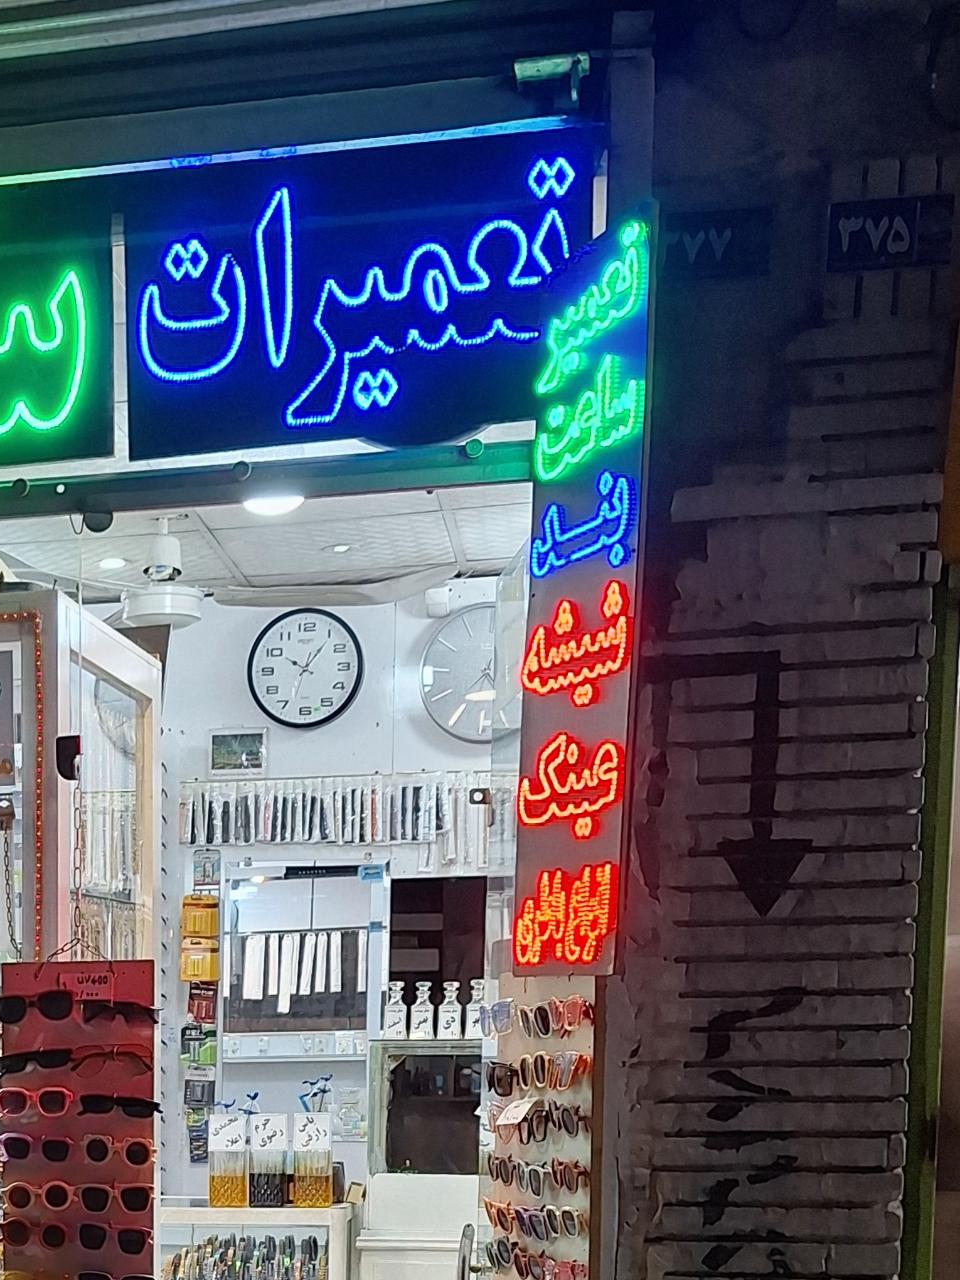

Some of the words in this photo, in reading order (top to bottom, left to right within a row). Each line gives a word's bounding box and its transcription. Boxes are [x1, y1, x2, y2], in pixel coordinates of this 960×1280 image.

[839, 215, 911, 254] ۳۷۵
[139, 156, 575, 427] تعمیرات
[535, 221, 645, 394] تعمیر
[536, 353, 642, 481] ساعت
[530, 470, 633, 579] بند
[298, 621, 317, 633] 12
[279, 631, 291, 641] 11
[333, 643, 347, 654] 2
[522, 579, 630, 707] شیشه
[266, 647, 283, 658] 10
[261, 666, 275, 676] 9
[337, 661, 351, 672] 3
[265, 685, 279, 695] 8
[332, 681, 345, 691] 4
[276, 699, 289, 710] 7
[320, 697, 334, 707] 5
[299, 706, 312, 716] 6
[518, 733, 623, 838] عینک
